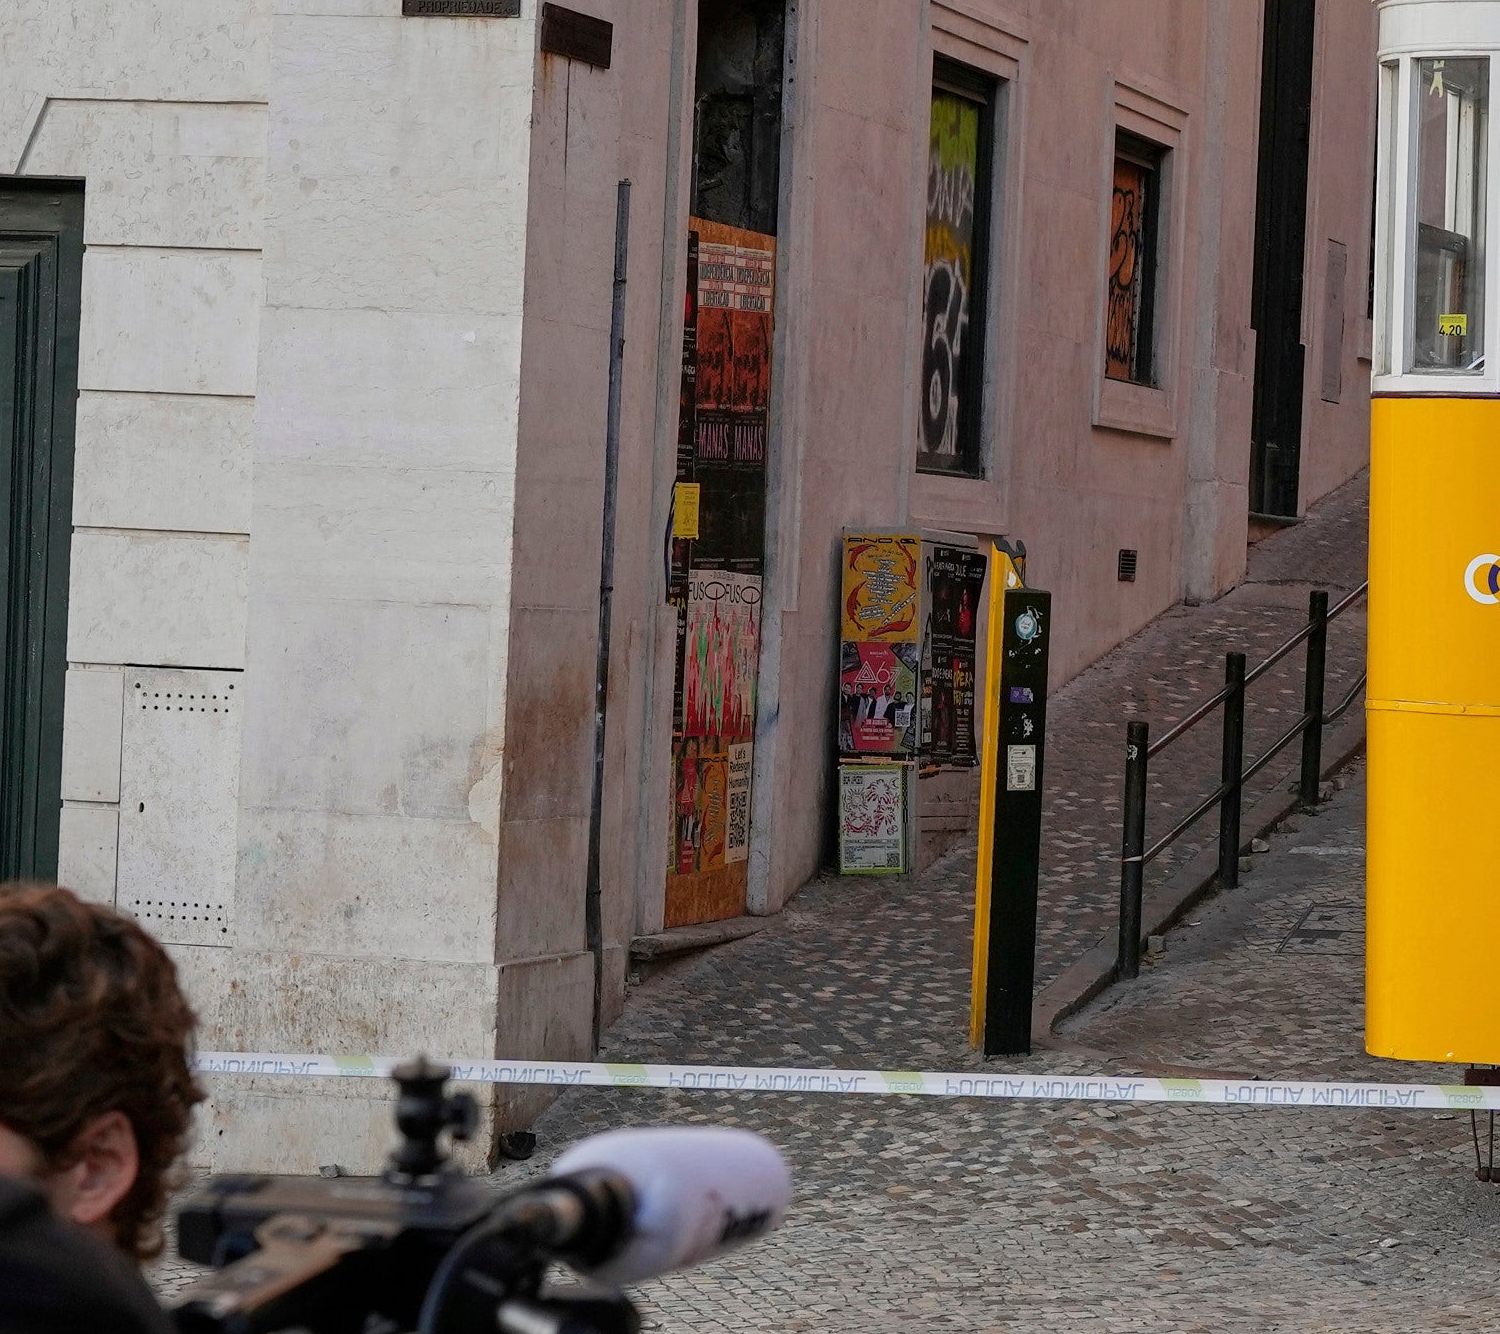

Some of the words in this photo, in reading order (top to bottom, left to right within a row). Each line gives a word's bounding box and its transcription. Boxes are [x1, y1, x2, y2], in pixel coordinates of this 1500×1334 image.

[1438, 325, 1461, 336] 4.20
[700, 422, 729, 459] MANAS
[734, 425, 763, 460] MANAS
